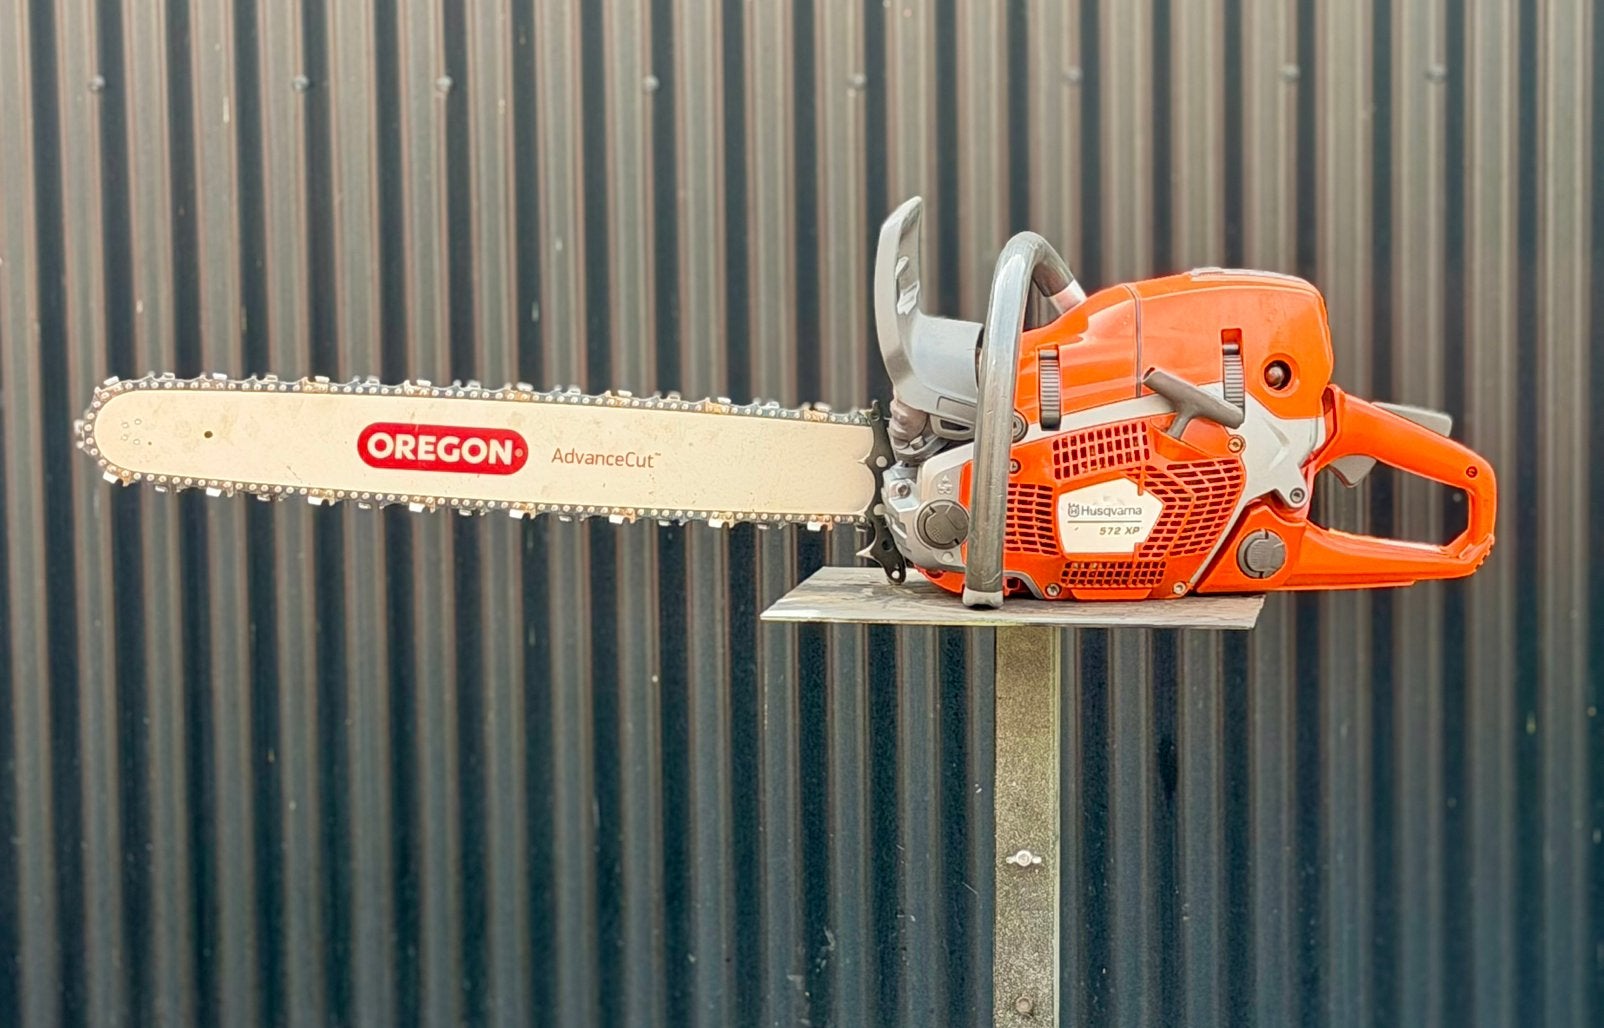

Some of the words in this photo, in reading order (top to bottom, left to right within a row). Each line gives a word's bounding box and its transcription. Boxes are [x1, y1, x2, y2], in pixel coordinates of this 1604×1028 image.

[367, 432, 513, 465] OREGON
[1081, 505, 1142, 517] Husqvarna
[1099, 526, 1121, 535] 572
[1124, 526, 1140, 535] XP
